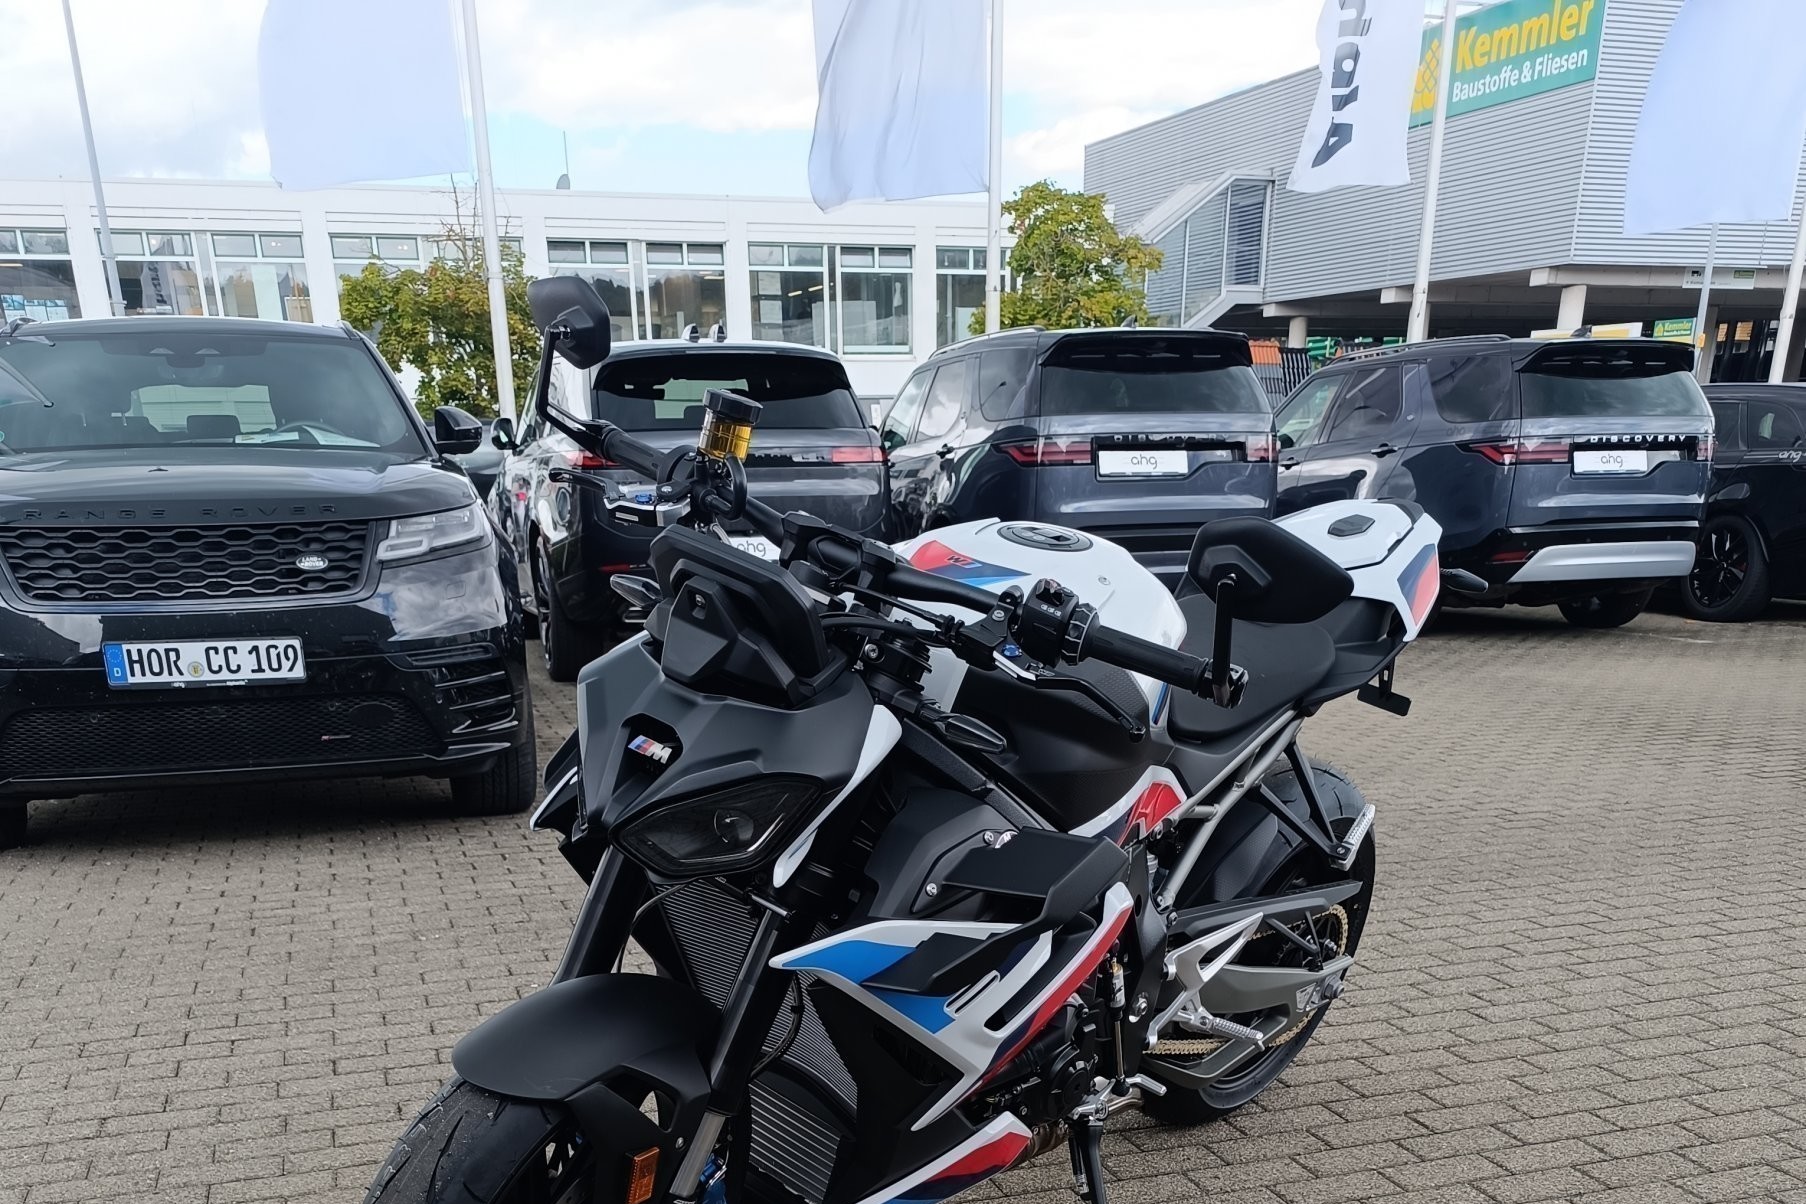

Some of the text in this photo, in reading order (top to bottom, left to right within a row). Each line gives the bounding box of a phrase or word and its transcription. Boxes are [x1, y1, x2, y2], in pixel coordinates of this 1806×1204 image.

[1455, 0, 1594, 73] Kemmler
[1452, 49, 1588, 102] Baustoffe & Fliesen
[1590, 435, 1686, 443] DISCOVERY
[1131, 454, 1158, 470] ahg
[1600, 453, 1624, 468] ahg
[23, 503, 338, 520] RANGE ROVER
[126, 644, 299, 677] HOR CC 109
[113, 667, 122, 676] D
